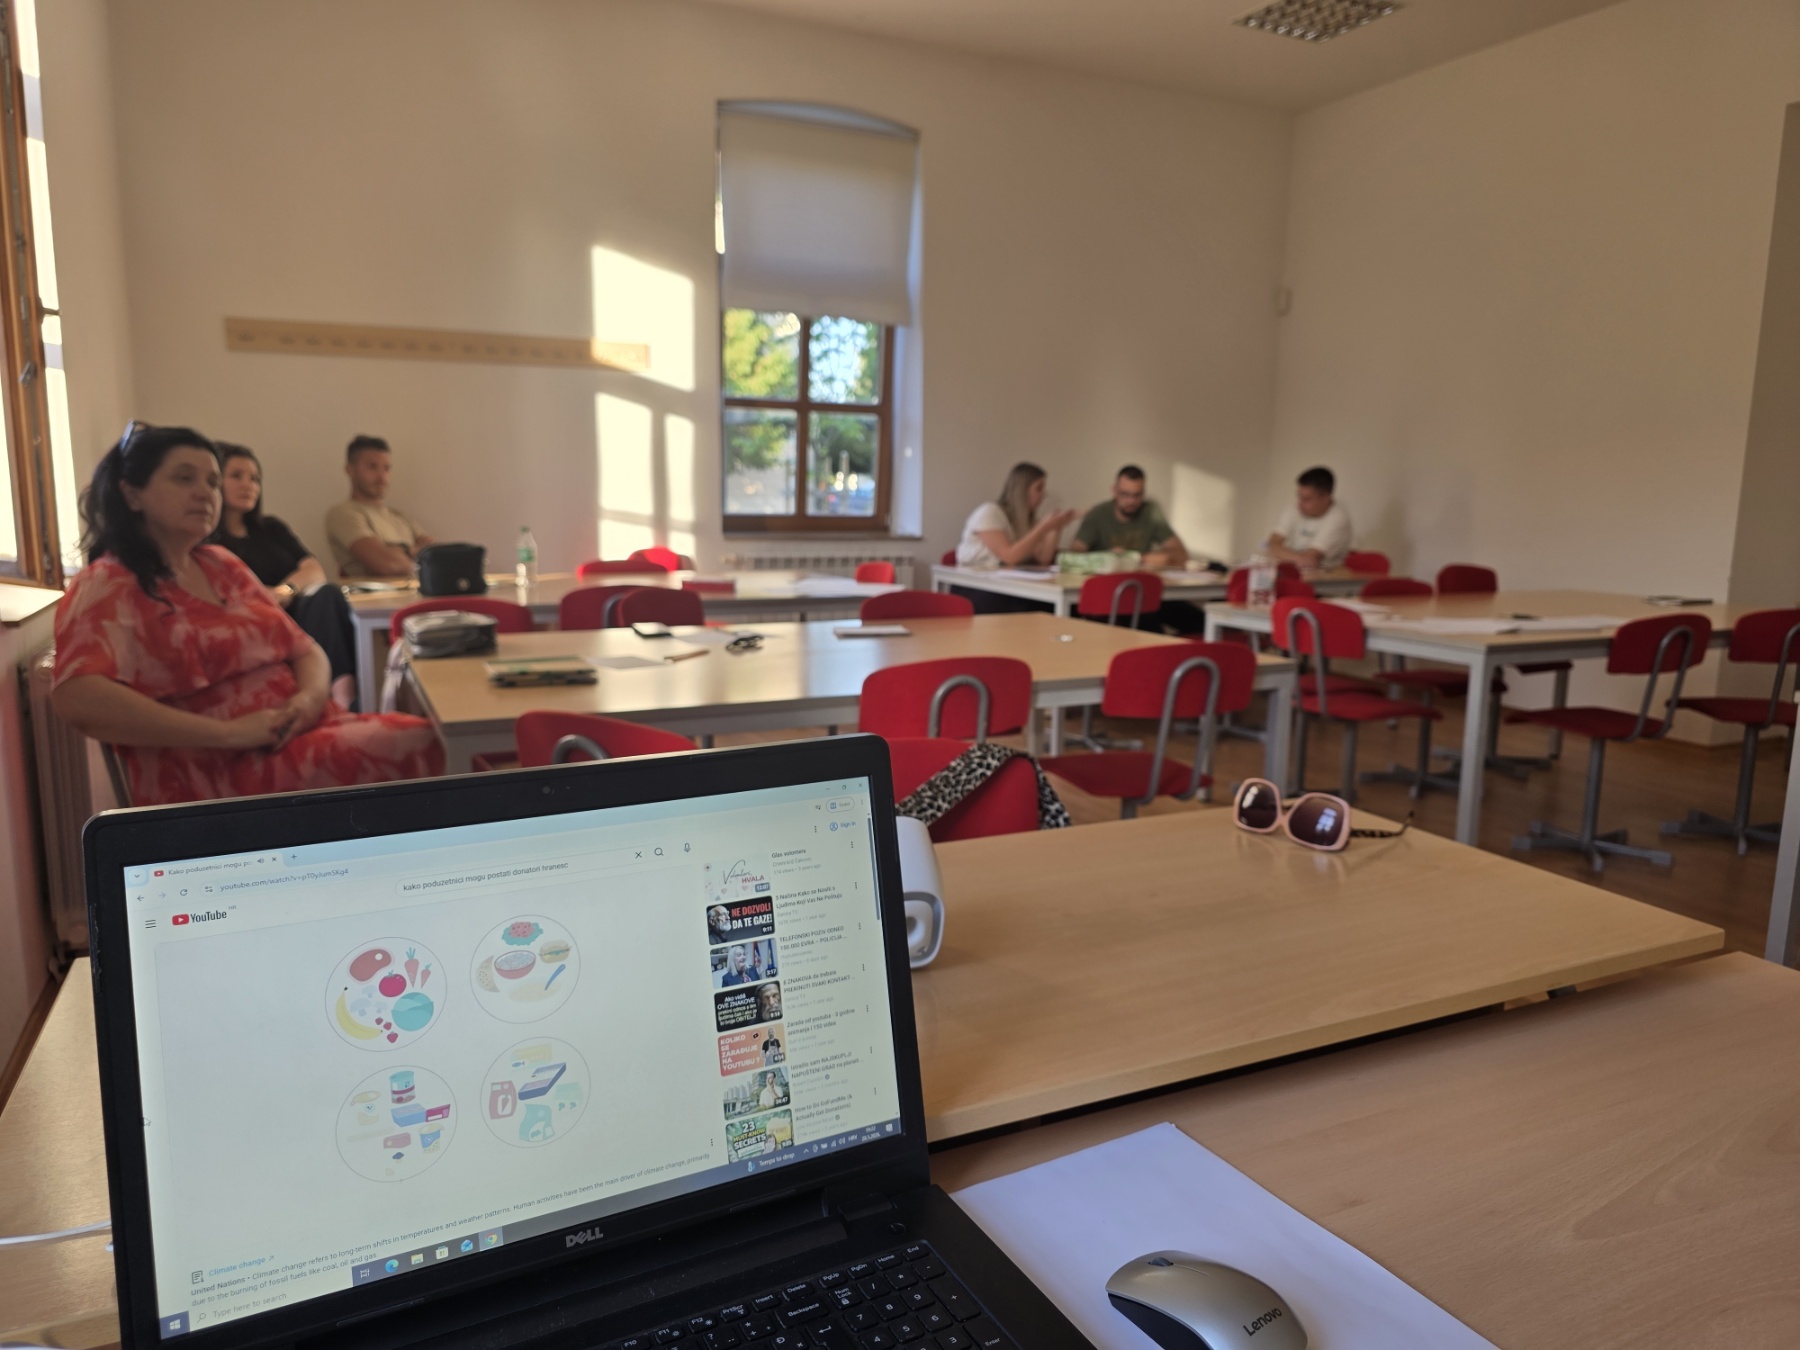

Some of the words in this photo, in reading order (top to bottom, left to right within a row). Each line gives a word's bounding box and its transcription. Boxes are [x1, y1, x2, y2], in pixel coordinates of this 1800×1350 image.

[224, 862, 242, 870] mogu
[403, 883, 421, 891] kako
[422, 877, 464, 890] poduzetnici
[466, 874, 486, 883] mogu
[487, 870, 511, 880] postati
[512, 866, 541, 876] donatori
[741, 875, 765, 884] HVALA
[731, 908, 741, 917] NE
[742, 902, 771, 915] DOZVOLI
[190, 909, 228, 924] YouTube
[732, 919, 743, 929] DA
[744, 917, 753, 927] TE
[753, 913, 773, 925] GAZE!
[720, 1034, 746, 1045] KOLIKO
[722, 1057, 733, 1065] NA
[723, 1058, 755, 1071] YOUTUBU
[742, 1121, 756, 1134] 23
[734, 1134, 767, 1150] SECRETS
[782, 1151, 796, 1162] drop
[191, 1284, 216, 1297] United
[217, 1276, 246, 1290] Nations
[252, 1267, 280, 1280] Climate
[281, 1260, 307, 1274] change
[308, 1255, 329, 1265] refers
[338, 1243, 372, 1259] long-term
[373, 1238, 392, 1248] shifts
[400, 1225, 444, 1242] temperatures
[445, 1221, 457, 1229] and
[458, 1214, 484, 1226] weather
[513, 1200, 535, 1211] Human
[536, 1193, 563, 1205] activities
[564, 1188, 578, 1197] have
[579, 1184, 594, 1193] been
[594, 1181, 604, 1189] the
[605, 1177, 619, 1186] main
[620, 1172, 636, 1182] driver
[644, 1165, 665, 1176] climate
[686, 1153, 710, 1165] primarily
[565, 1226, 604, 1248] DELL
[907, 1245, 919, 1253] End
[878, 1254, 895, 1263] Home
[208, 1264, 237, 1277] Climate
[239, 1257, 266, 1271] change
[850, 1262, 868, 1272] PgDn
[191, 1297, 207, 1307] due
[208, 1295, 216, 1303] to
[217, 1291, 229, 1300] the
[230, 1283, 258, 1298] burning
[259, 1281, 268, 1289] of
[269, 1275, 289, 1286] fossil
[290, 1270, 307, 1281] fuels
[309, 1267, 321, 1276] like
[340, 1259, 349, 1267] oil
[350, 1255, 363, 1265] and
[822, 1272, 840, 1282] PgUp
[787, 1283, 806, 1293] Delete
[834, 1287, 850, 1295] Num
[755, 1294, 774, 1304] Insert
[914, 1293, 922, 1301] 9
[213, 1307, 231, 1319] Type
[234, 1302, 252, 1313] here
[262, 1292, 287, 1305] search
[787, 1302, 820, 1317] Backspace
[886, 1303, 894, 1311] 8
[691, 1317, 704, 1325] F12
[856, 1313, 863, 1321] 7
[1243, 1307, 1283, 1337] Lenovo
[658, 1328, 670, 1336] F11
[624, 1339, 637, 1348] F10
[984, 1337, 1001, 1347] Enter
